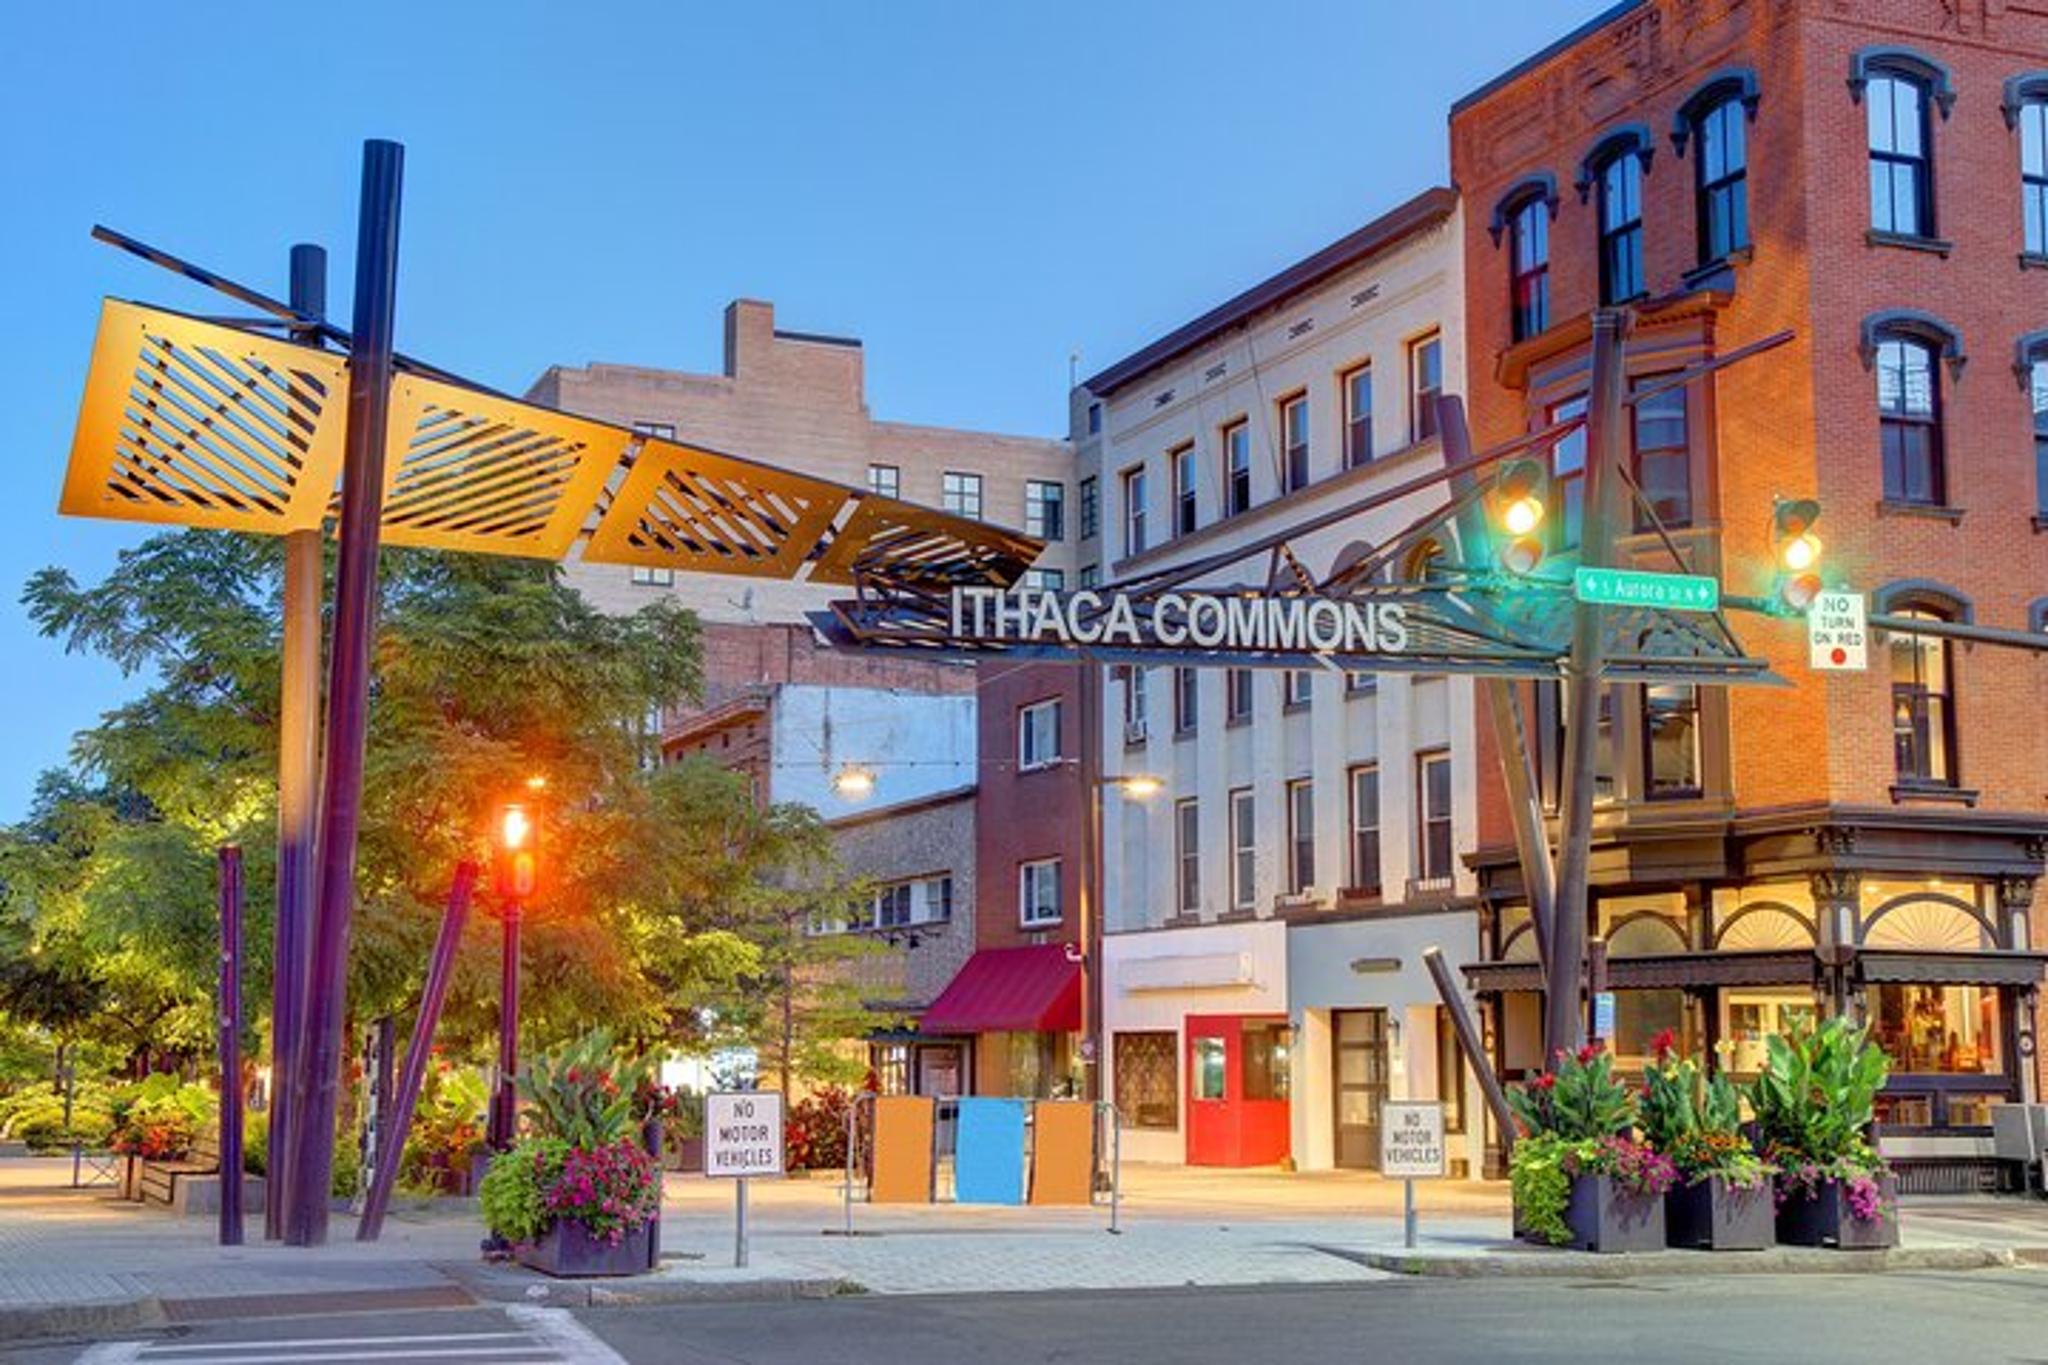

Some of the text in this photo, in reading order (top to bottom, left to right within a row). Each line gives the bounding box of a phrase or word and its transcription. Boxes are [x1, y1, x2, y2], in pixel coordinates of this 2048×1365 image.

[1615, 578, 1665, 599] Aurora
[1823, 597, 1850, 613] NO
[951, 586, 1408, 652] ITHACA COMMONS
[1821, 615, 1856, 630] TURN
[1814, 631, 1861, 647] ON RED
[733, 1101, 754, 1119] NO
[1404, 1112, 1420, 1128] NO
[719, 1125, 769, 1143] MOTOR
[1392, 1129, 1432, 1146] MOTOR
[716, 1148, 772, 1169] VEHICLES
[1386, 1147, 1440, 1164] VEHICLES
